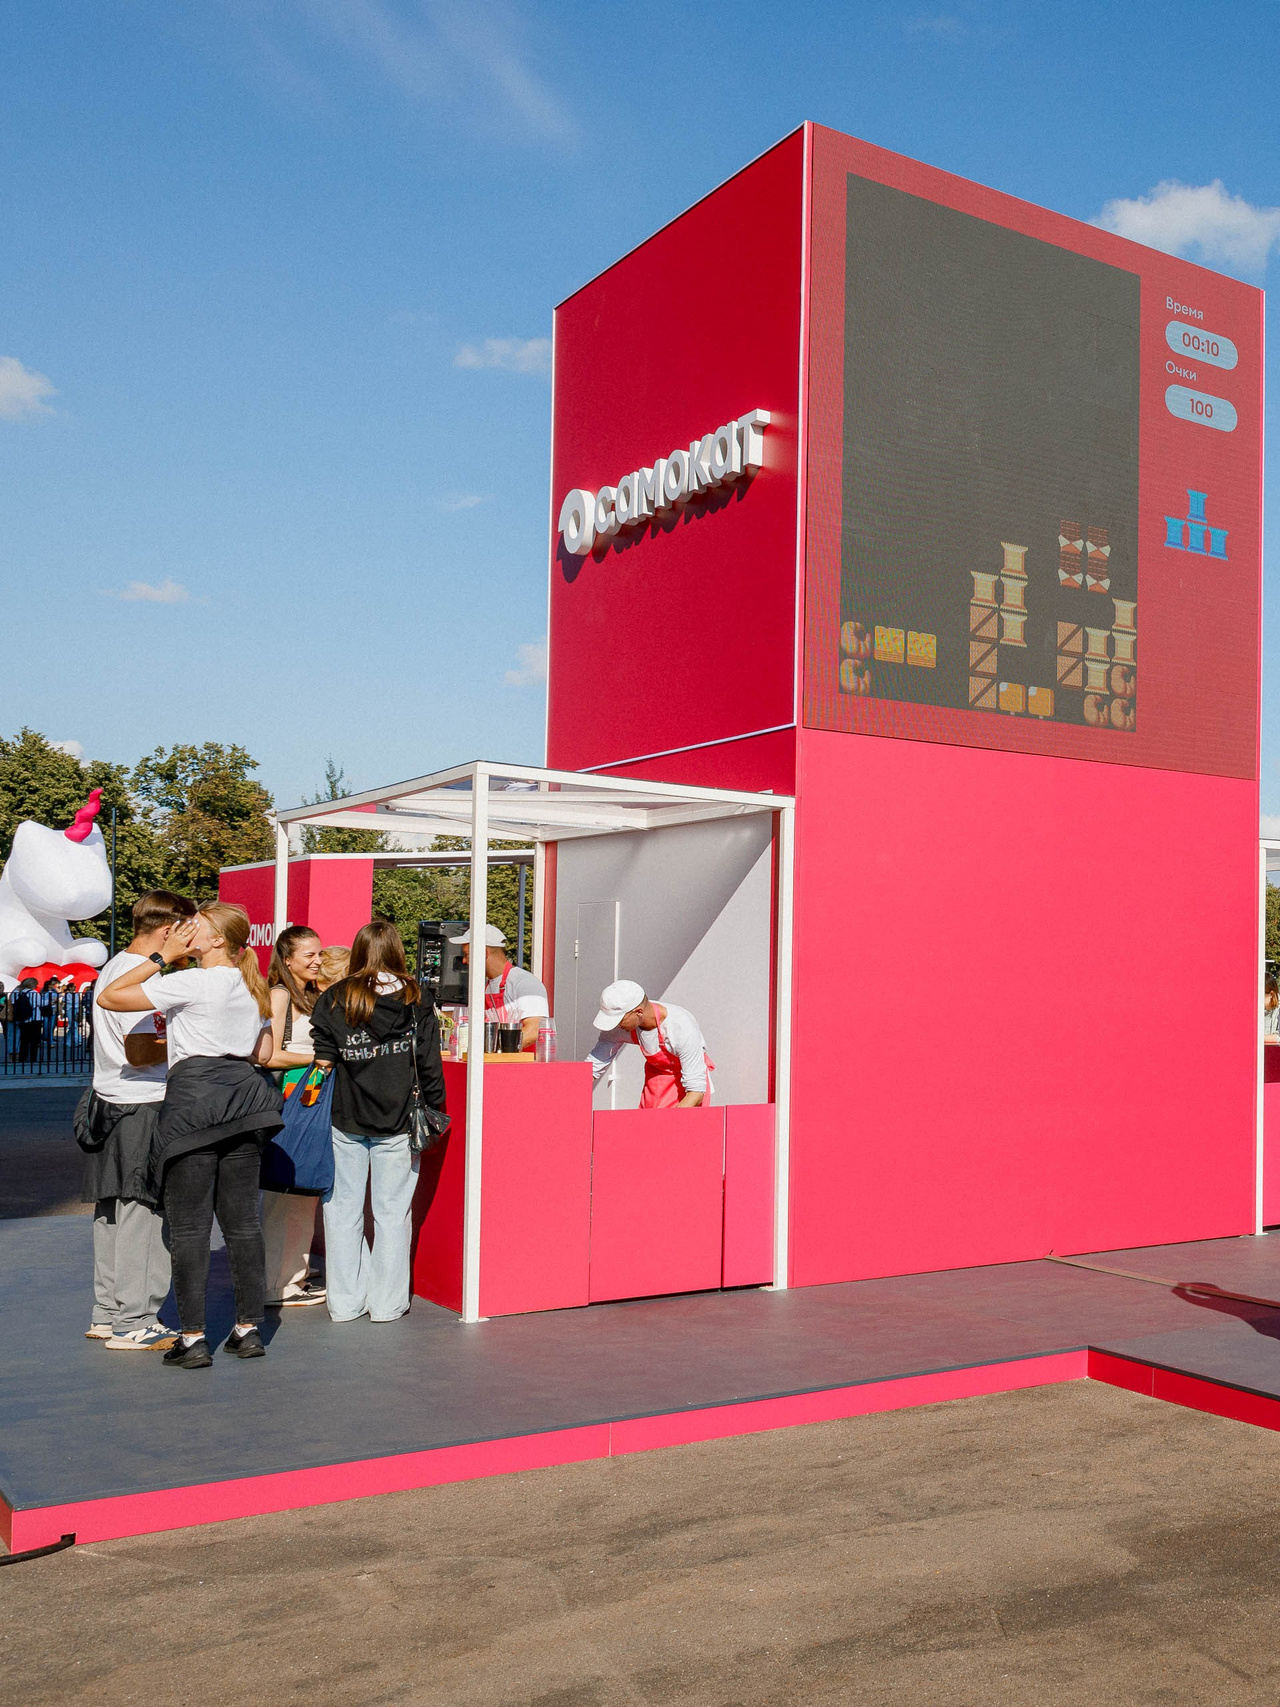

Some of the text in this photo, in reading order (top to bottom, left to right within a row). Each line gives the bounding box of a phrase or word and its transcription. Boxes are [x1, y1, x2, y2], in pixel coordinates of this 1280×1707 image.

[1166, 296, 1204, 321] Время
[1182, 331, 1220, 357] 00:10
[1165, 360, 1198, 381] Очки
[1189, 398, 1214, 418] 100
[392, 1039, 412, 1054] ЕС
